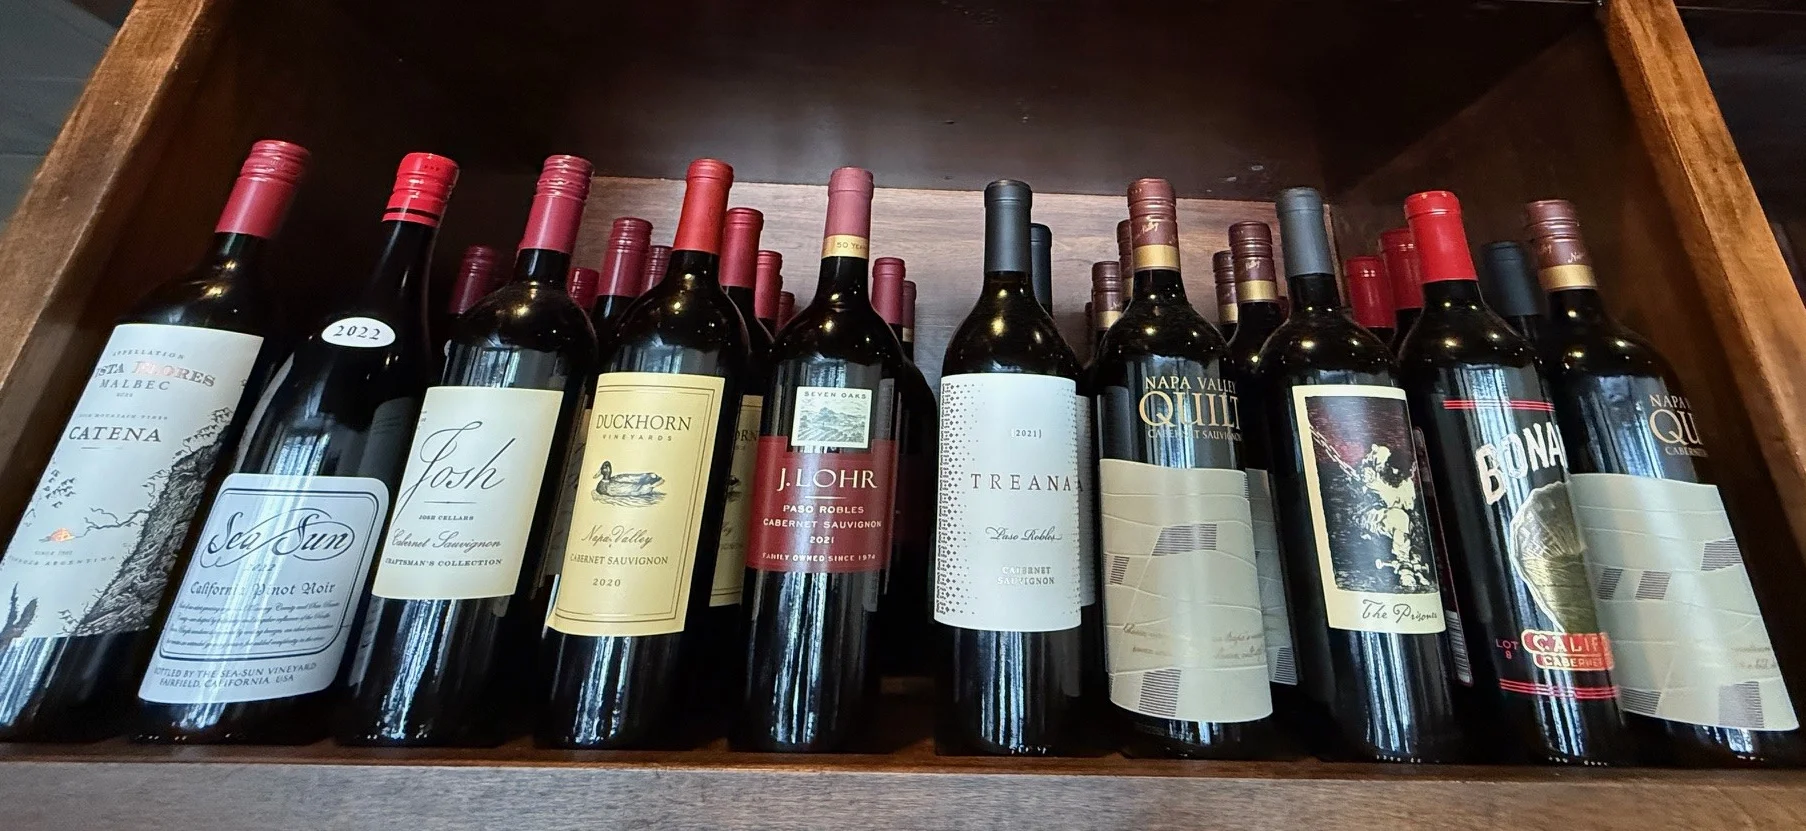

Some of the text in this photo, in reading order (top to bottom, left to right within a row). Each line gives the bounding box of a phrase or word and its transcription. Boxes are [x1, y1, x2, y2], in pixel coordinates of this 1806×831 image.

[333, 325, 380, 340] 2022
[112, 349, 185, 360] APPELLATION
[99, 378, 171, 391] MALBEC
[1145, 375, 1237, 394] NAPA VALLEY
[841, 392, 867, 400] OAKS
[1649, 394, 1687, 410] NAPA
[1138, 390, 1241, 431] QUILT
[596, 414, 692, 431] DUCKHORN
[68, 426, 162, 443] CATENA
[602, 434, 672, 442] VINEYARDS
[392, 421, 516, 525] Josh
[970, 473, 1071, 492] TREANA
[782, 504, 865, 514] PASO ROBLES
[763, 518, 882, 529] CABERNET SAUVIGNON
[207, 511, 350, 556] Sea Sun
[391, 528, 502, 554] Cabernet Sauvignon
[581, 525, 653, 549] Napa Valley
[809, 536, 834, 544] 2021
[985, 526, 1063, 542] Paso Robles
[437, 559, 503, 567] COLLECTION
[570, 553, 669, 566] CABERNET SAUVIGNON
[762, 552, 789, 560] FAMILY
[792, 554, 825, 562] OWNED
[592, 578, 621, 587] 2020
[997, 566, 1055, 585] CABERNET SAUVIGNON
[300, 581, 336, 596] Noir
[1362, 599, 1388, 619] The
[1496, 638, 1519, 650] LOT
[183, 668, 194, 678] BY
[198, 669, 216, 678] THE
[220, 667, 264, 678] SEA-SUN
[268, 662, 318, 676] VINEYARD
[275, 674, 294, 683] USA
